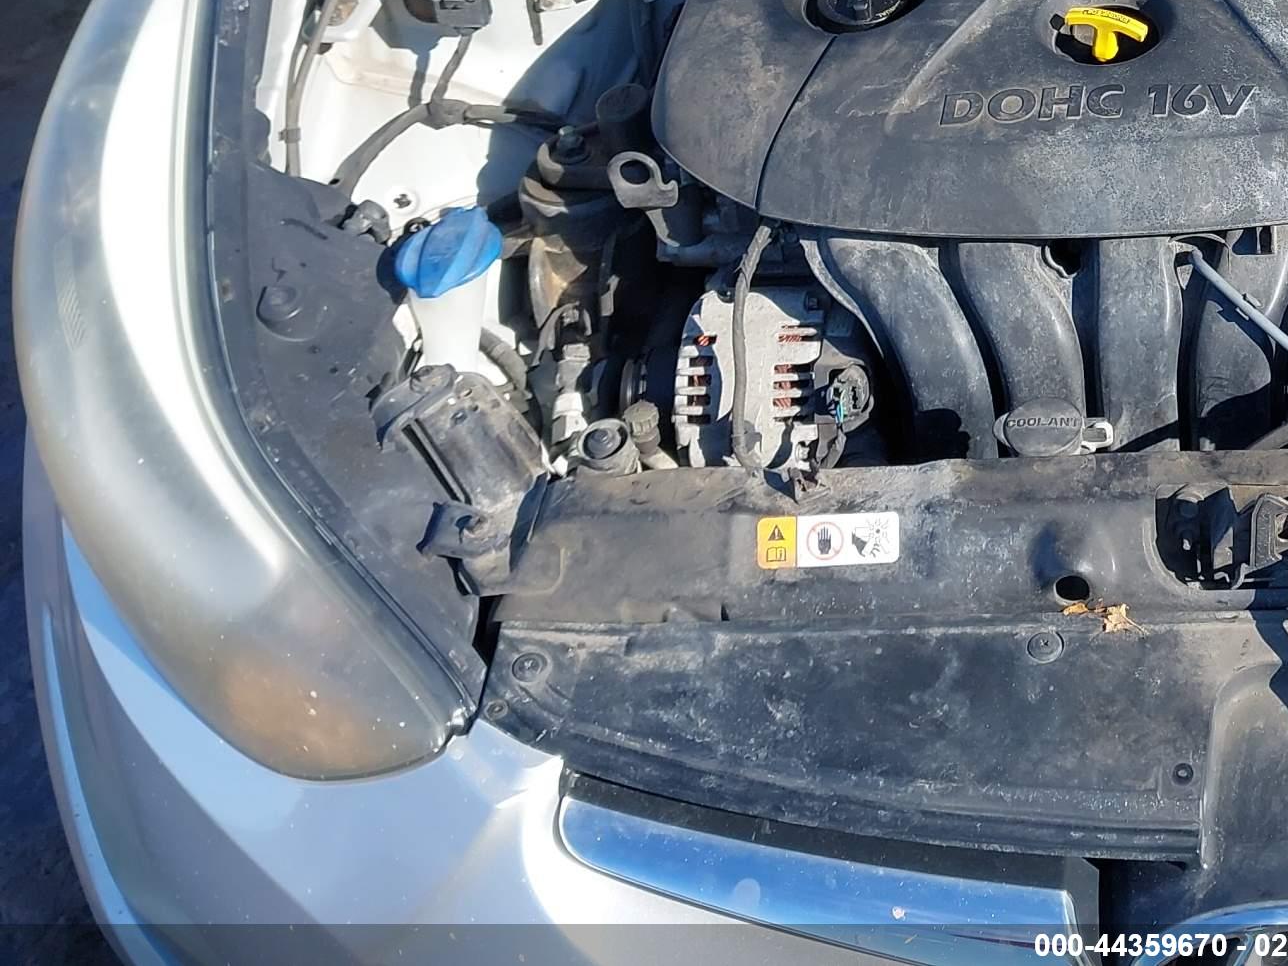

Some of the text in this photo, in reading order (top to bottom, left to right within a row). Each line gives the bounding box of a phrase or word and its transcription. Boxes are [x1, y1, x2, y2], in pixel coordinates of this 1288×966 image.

[940, 83, 1258, 126] DOHC 16V
[1006, 417, 1077, 428] COOLANT
